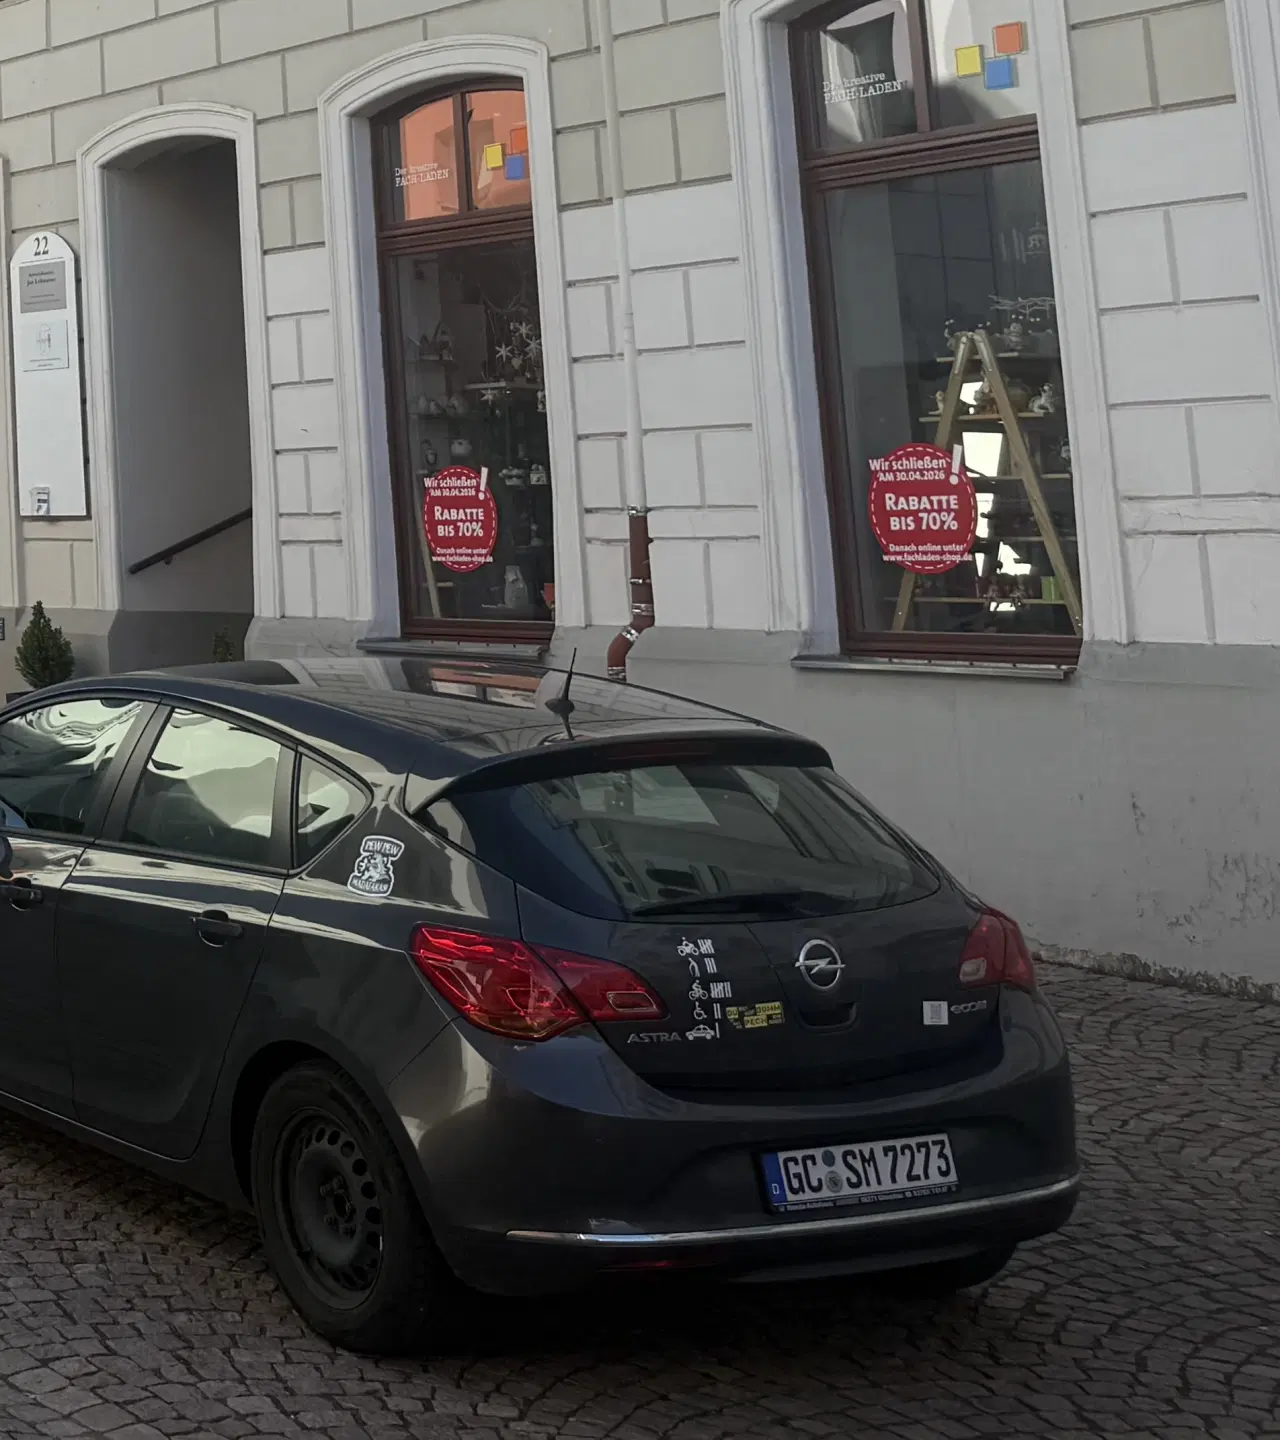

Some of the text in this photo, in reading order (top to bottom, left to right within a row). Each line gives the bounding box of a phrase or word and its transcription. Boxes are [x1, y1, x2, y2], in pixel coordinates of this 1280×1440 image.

[843, 73, 886, 87] kreative
[33, 235, 49, 257] 22
[868, 458, 890, 471] Wir
[892, 456, 947, 471] schließen
[423, 477, 438, 488] Wir
[439, 476, 477, 487] schließen
[878, 470, 945, 482] AM 30.04.2026
[884, 493, 959, 511] RABATTE
[434, 506, 485, 521] RABATTE
[890, 512, 959, 531] BIS 70%
[437, 522, 484, 537] BIS 70%
[889, 543, 917, 552] Danach
[918, 543, 942, 552] online
[627, 1031, 682, 1044] ASTRA
[772, 1139, 952, 1196] D GC SM 7273
